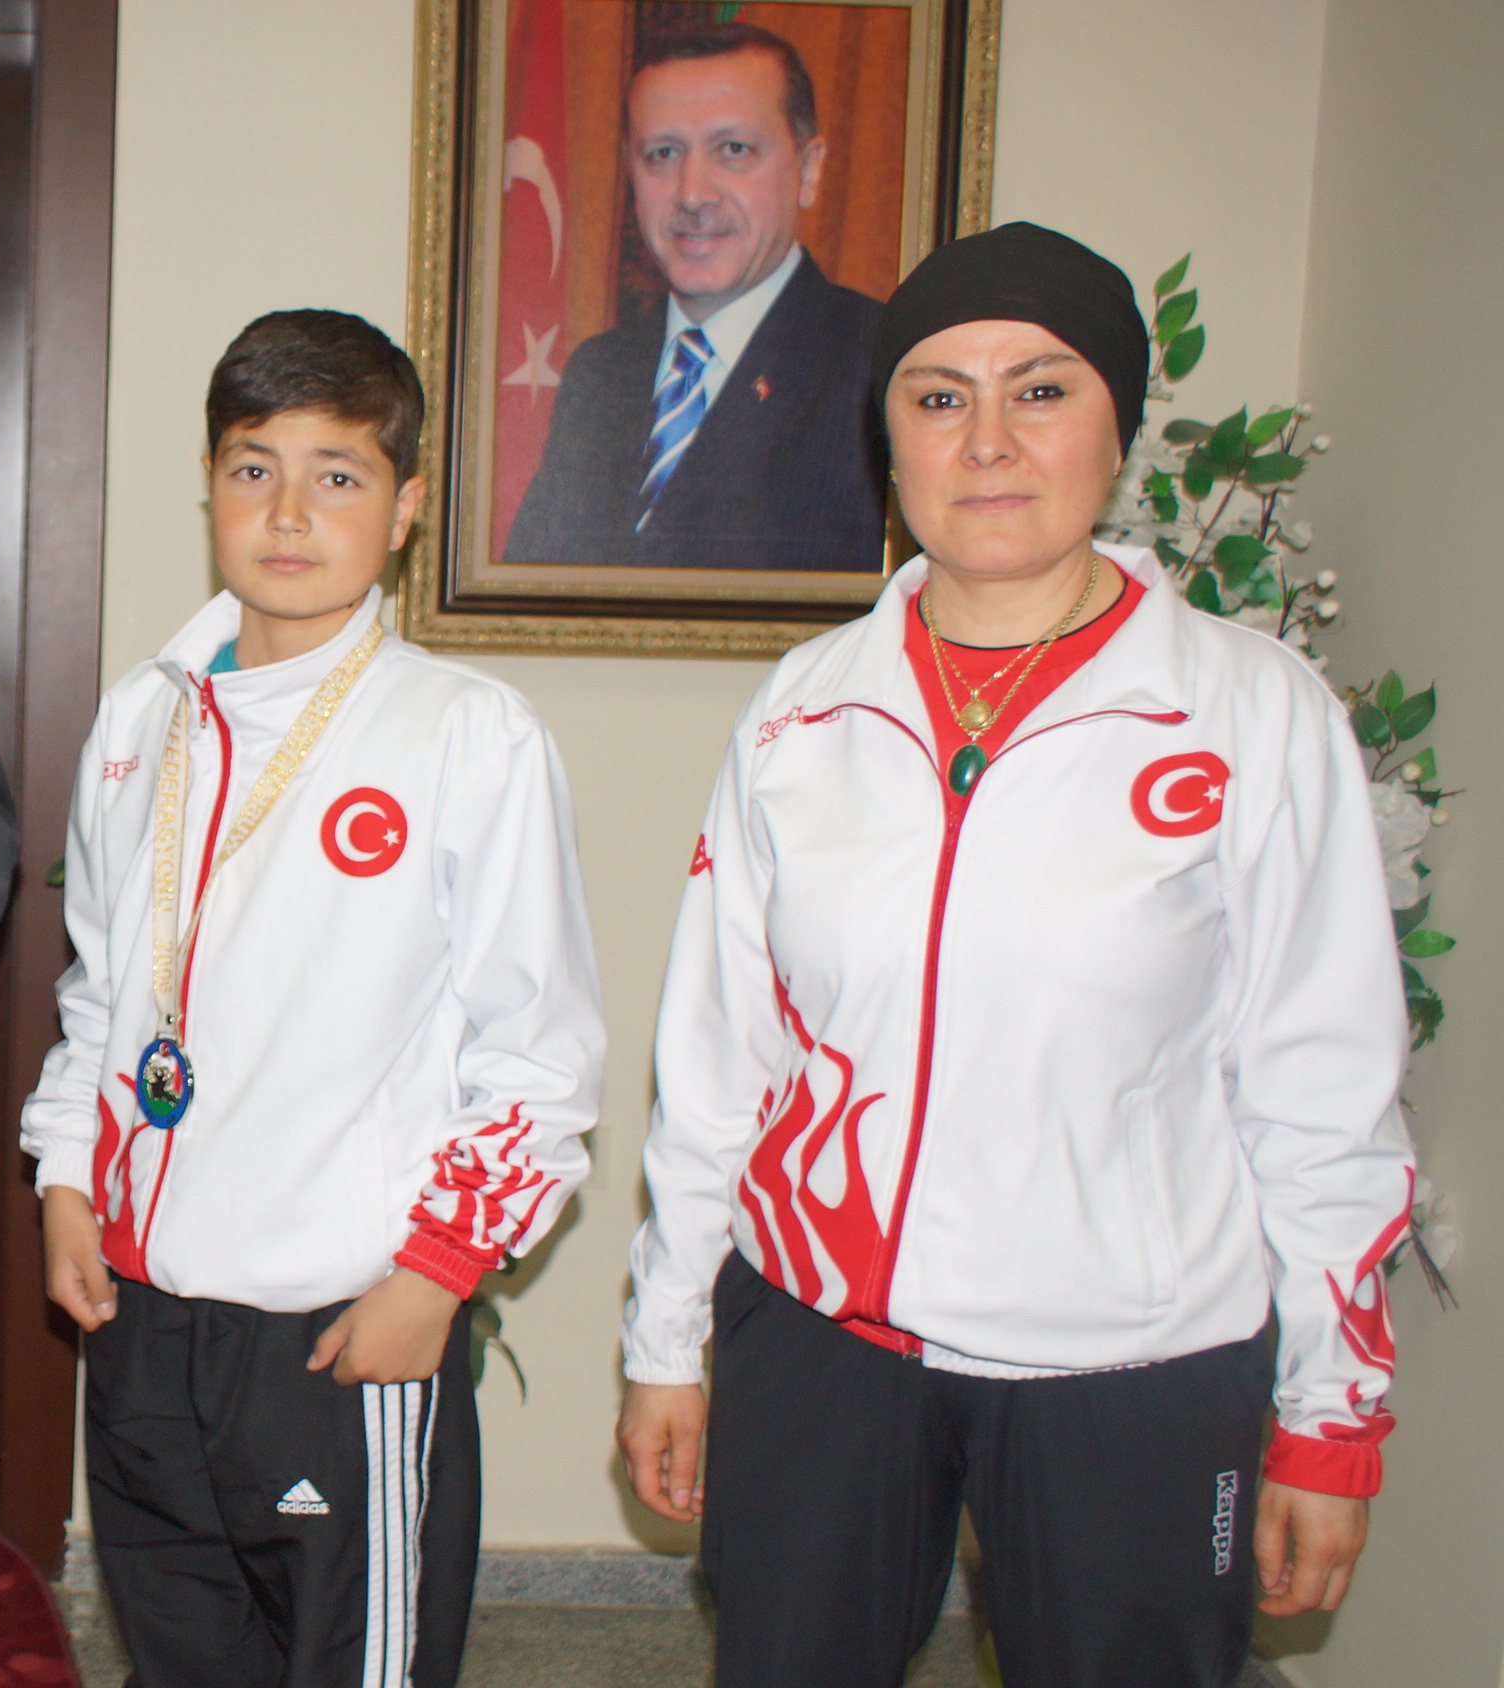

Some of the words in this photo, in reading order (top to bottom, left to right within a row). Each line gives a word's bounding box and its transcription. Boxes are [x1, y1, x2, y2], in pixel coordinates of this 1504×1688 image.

[156, 732, 180, 911] FEDERASYONU
[277, 1501, 330, 1515] adidas
[1213, 1470, 1238, 1575] Kappa
